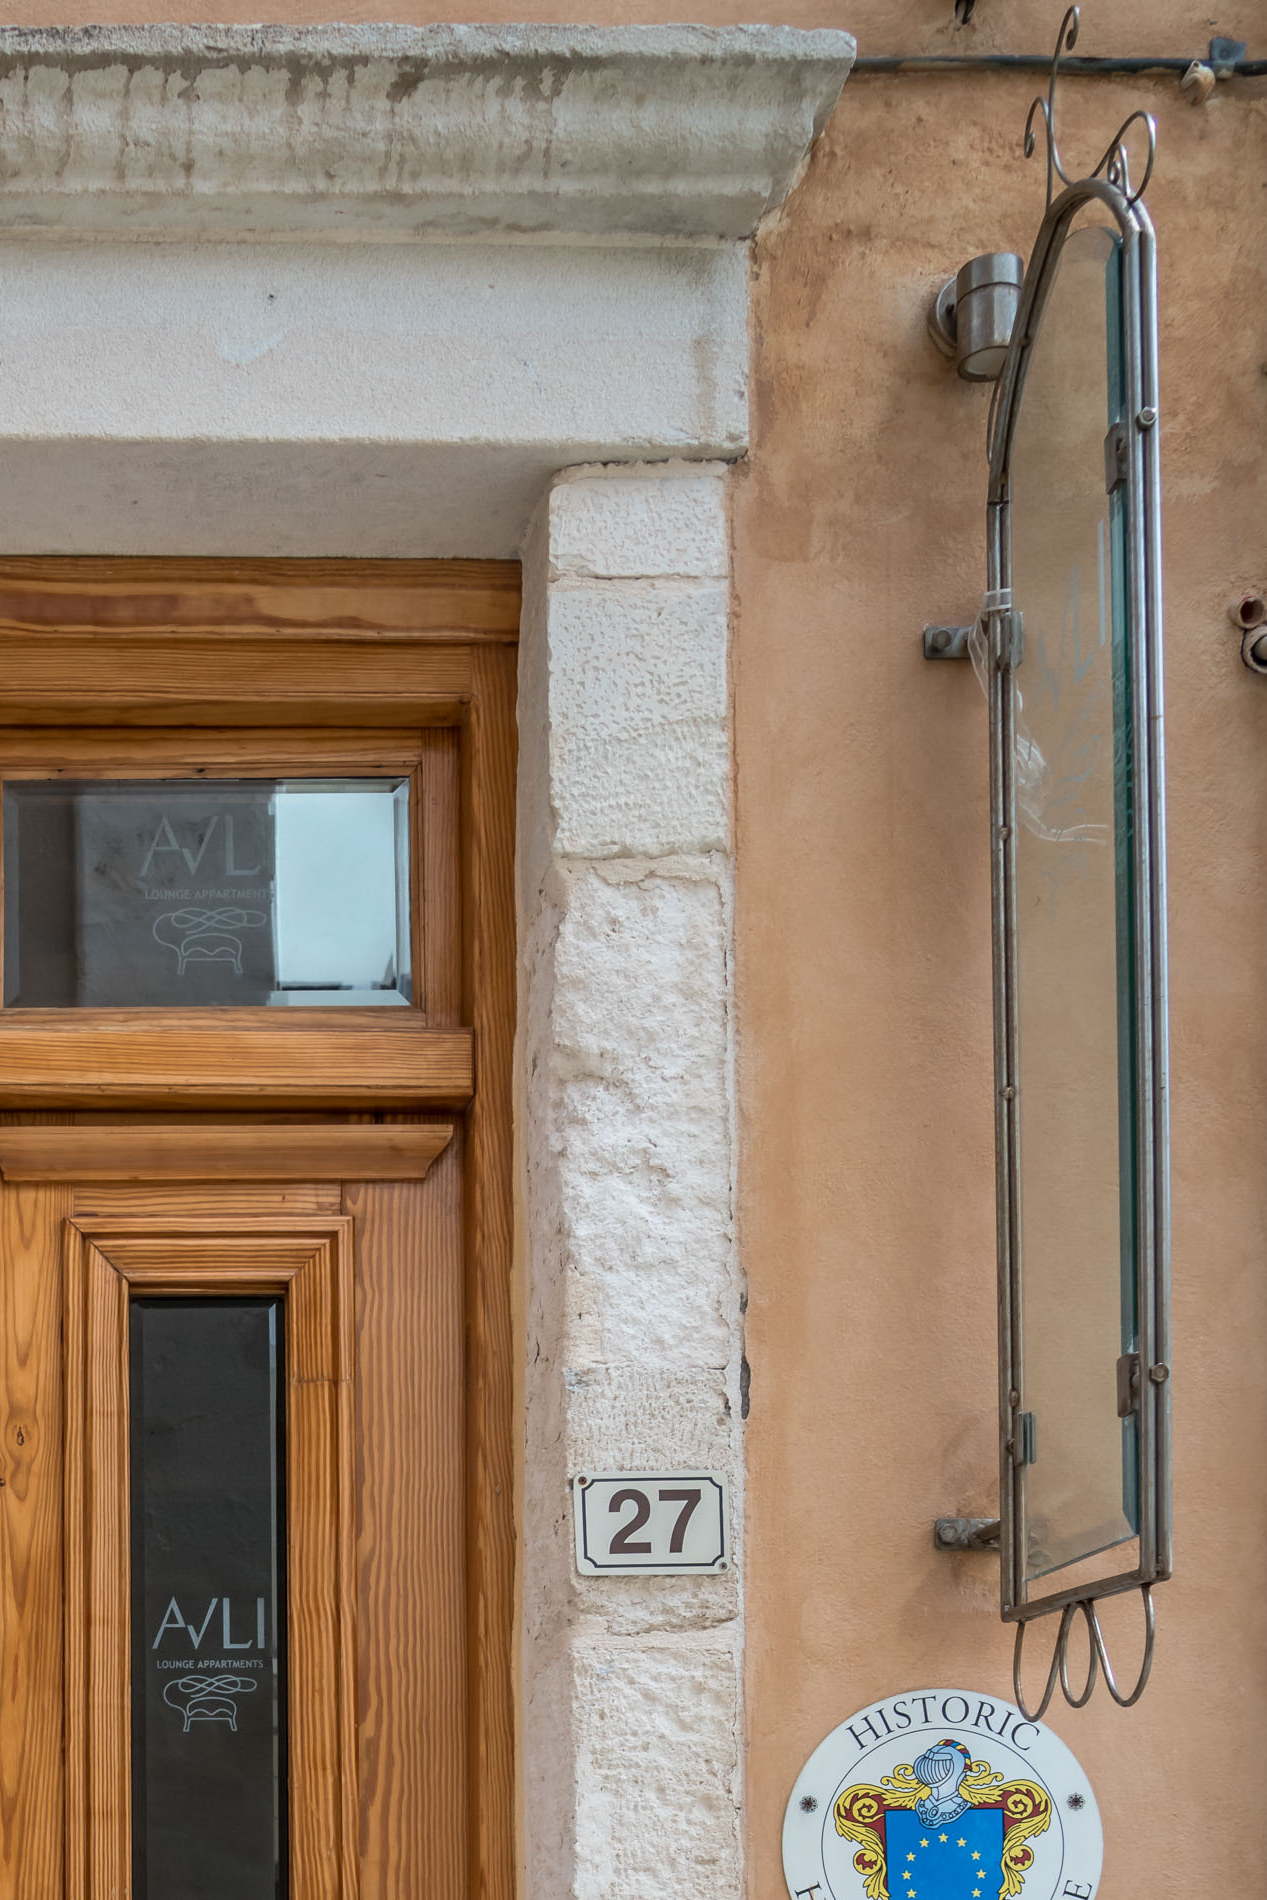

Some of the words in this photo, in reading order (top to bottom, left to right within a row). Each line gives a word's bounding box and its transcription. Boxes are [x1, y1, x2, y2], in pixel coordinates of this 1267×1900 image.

[144, 888, 192, 900] LOUNGE
[608, 1488, 702, 1555] 27
[152, 1596, 266, 1650] AVLI
[156, 1659, 195, 1669] LOUNGE
[197, 1659, 264, 1669] APPARTMENTS
[844, 1695, 1041, 1752] HISTORIC
